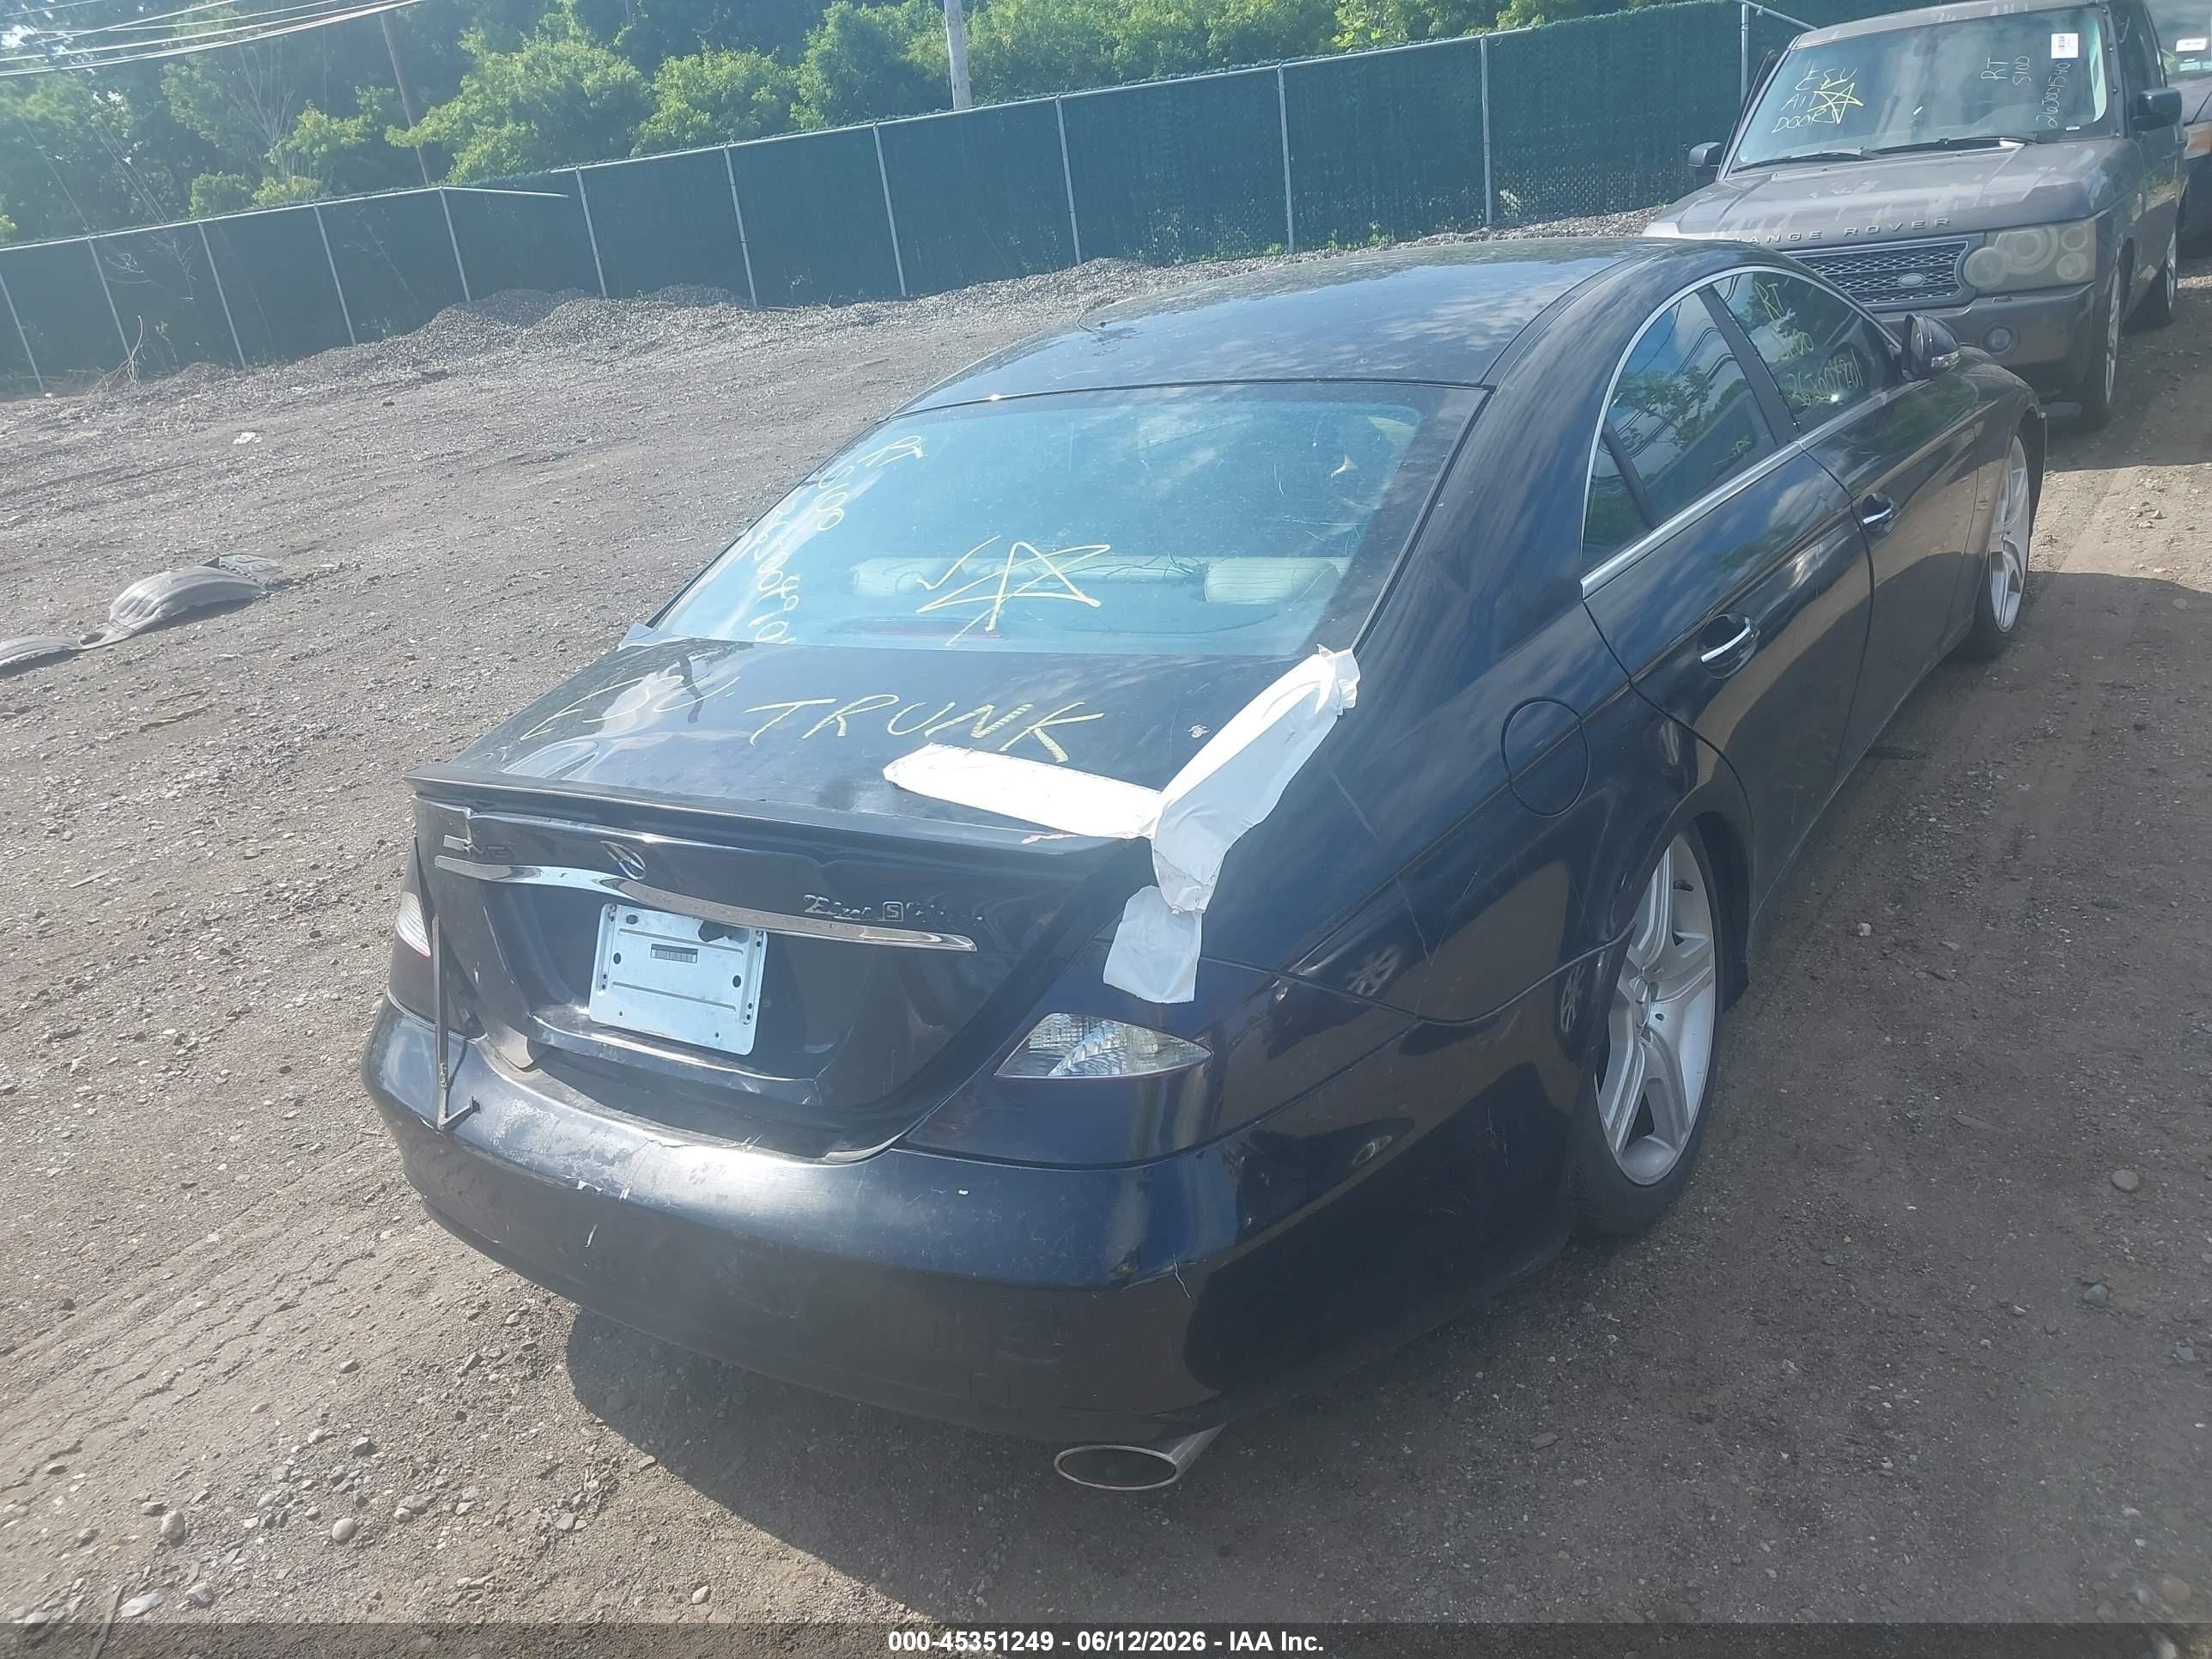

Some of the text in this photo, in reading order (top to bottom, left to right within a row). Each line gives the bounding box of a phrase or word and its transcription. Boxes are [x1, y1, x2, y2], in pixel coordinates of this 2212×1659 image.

[1980, 57, 2009, 79] RT
[1844, 217, 1950, 237] ROVER
[1754, 281, 1784, 321] RT
[857, 434, 927, 469] RT
[744, 693, 1105, 763] TRUNK
